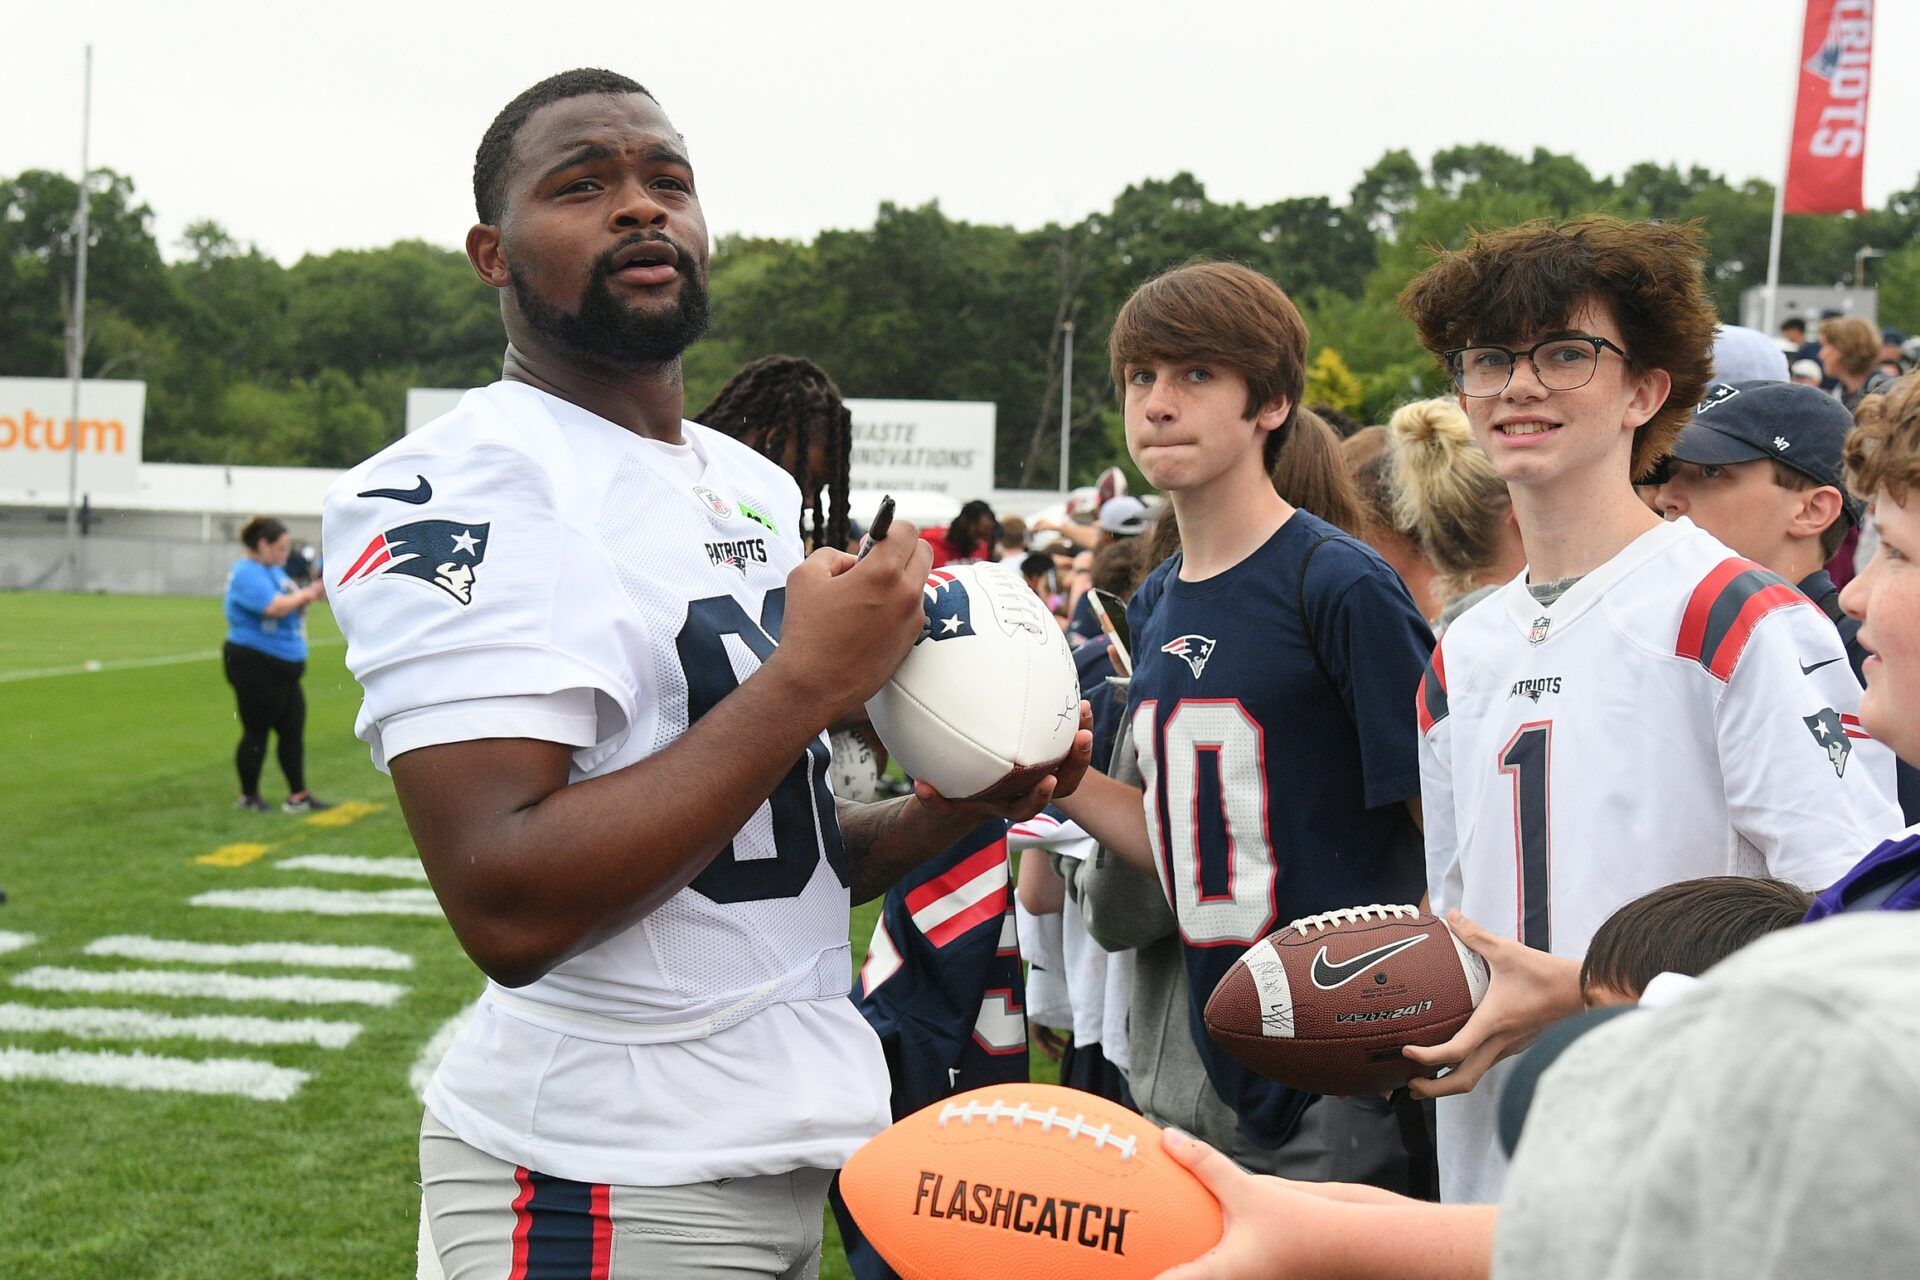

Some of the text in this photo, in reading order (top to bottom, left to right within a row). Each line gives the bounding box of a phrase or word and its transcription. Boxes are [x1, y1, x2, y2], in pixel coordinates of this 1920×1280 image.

[704, 538, 768, 567] PATRIOTS
[1508, 676, 1562, 699] ATRIOTS
[1132, 697, 1279, 948] 10
[1497, 718, 1553, 954] 1
[913, 1171, 1132, 1256] FLASHCATCH
